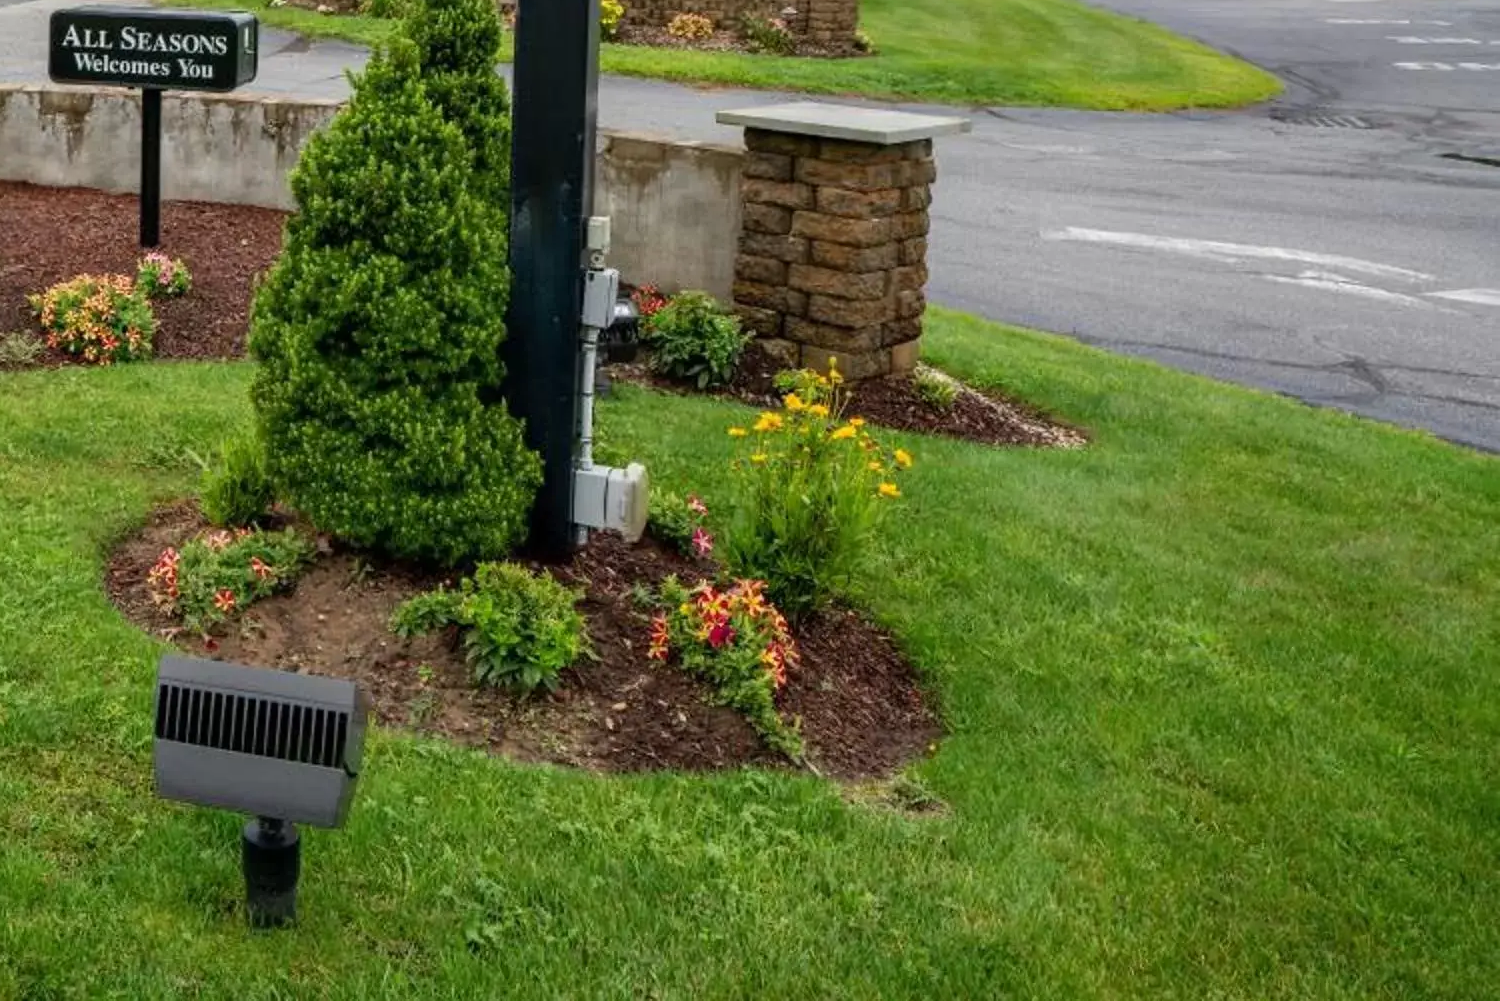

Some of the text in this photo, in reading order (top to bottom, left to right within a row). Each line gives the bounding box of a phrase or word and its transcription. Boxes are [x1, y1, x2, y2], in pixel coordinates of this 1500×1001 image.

[63, 25, 227, 55] ALL SEASONS
[74, 52, 213, 78] Welcomes You
